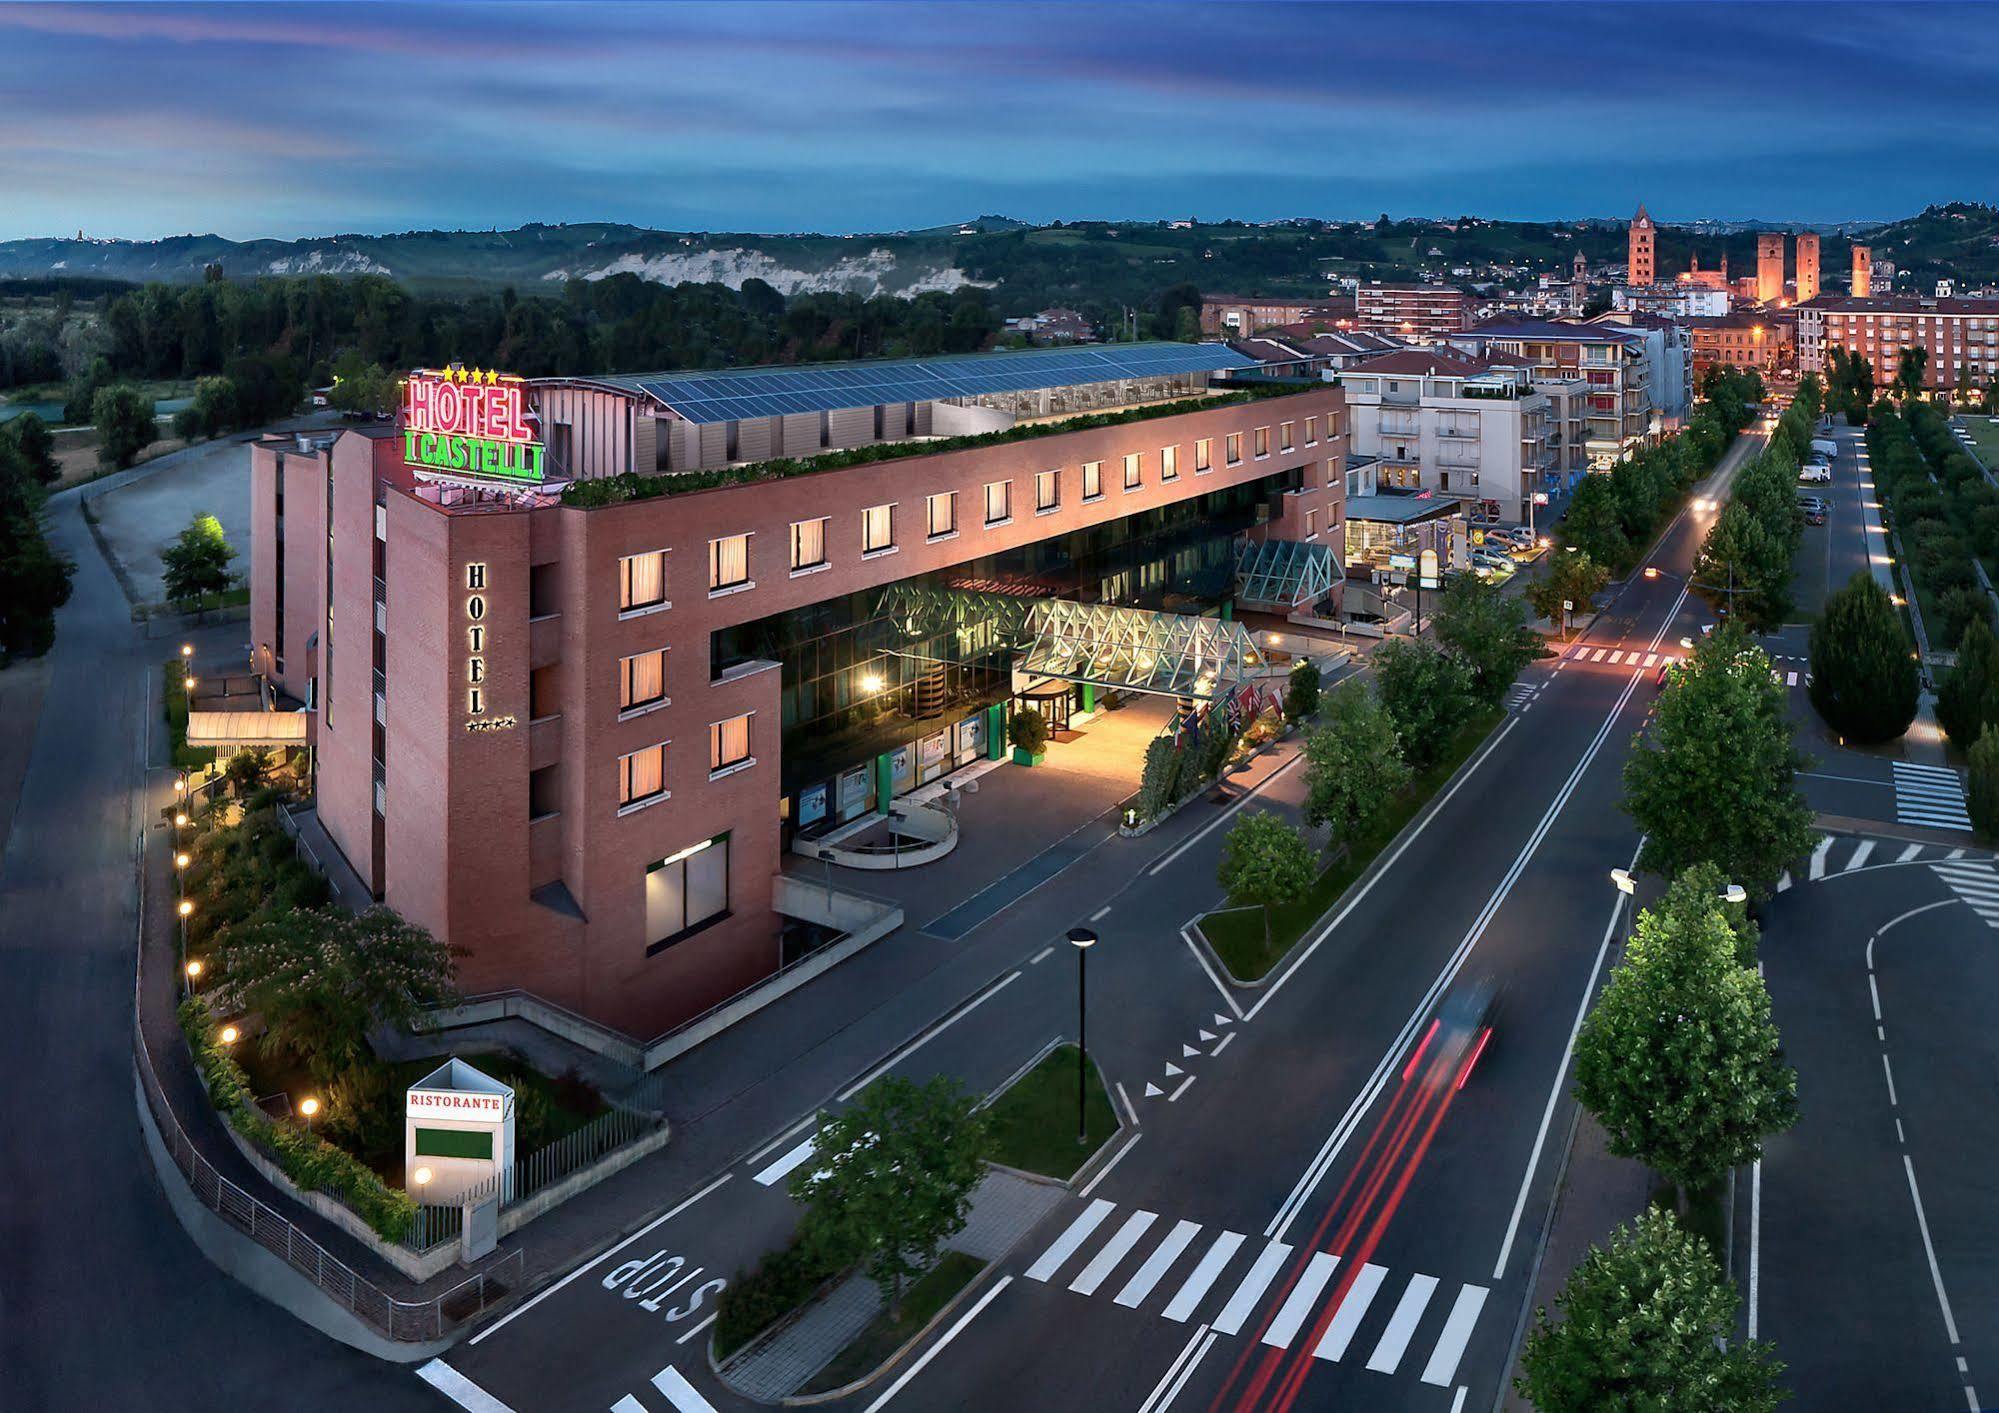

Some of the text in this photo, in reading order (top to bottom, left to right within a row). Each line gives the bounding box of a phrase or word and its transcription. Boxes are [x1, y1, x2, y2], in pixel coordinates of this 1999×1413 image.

[409, 379, 532, 441] HOTEL
[404, 430, 546, 480] I CASTELLI
[468, 563, 485, 714] HOTEL
[410, 1094, 500, 1110] RISTORANTE
[602, 1250, 727, 1322] STOP
